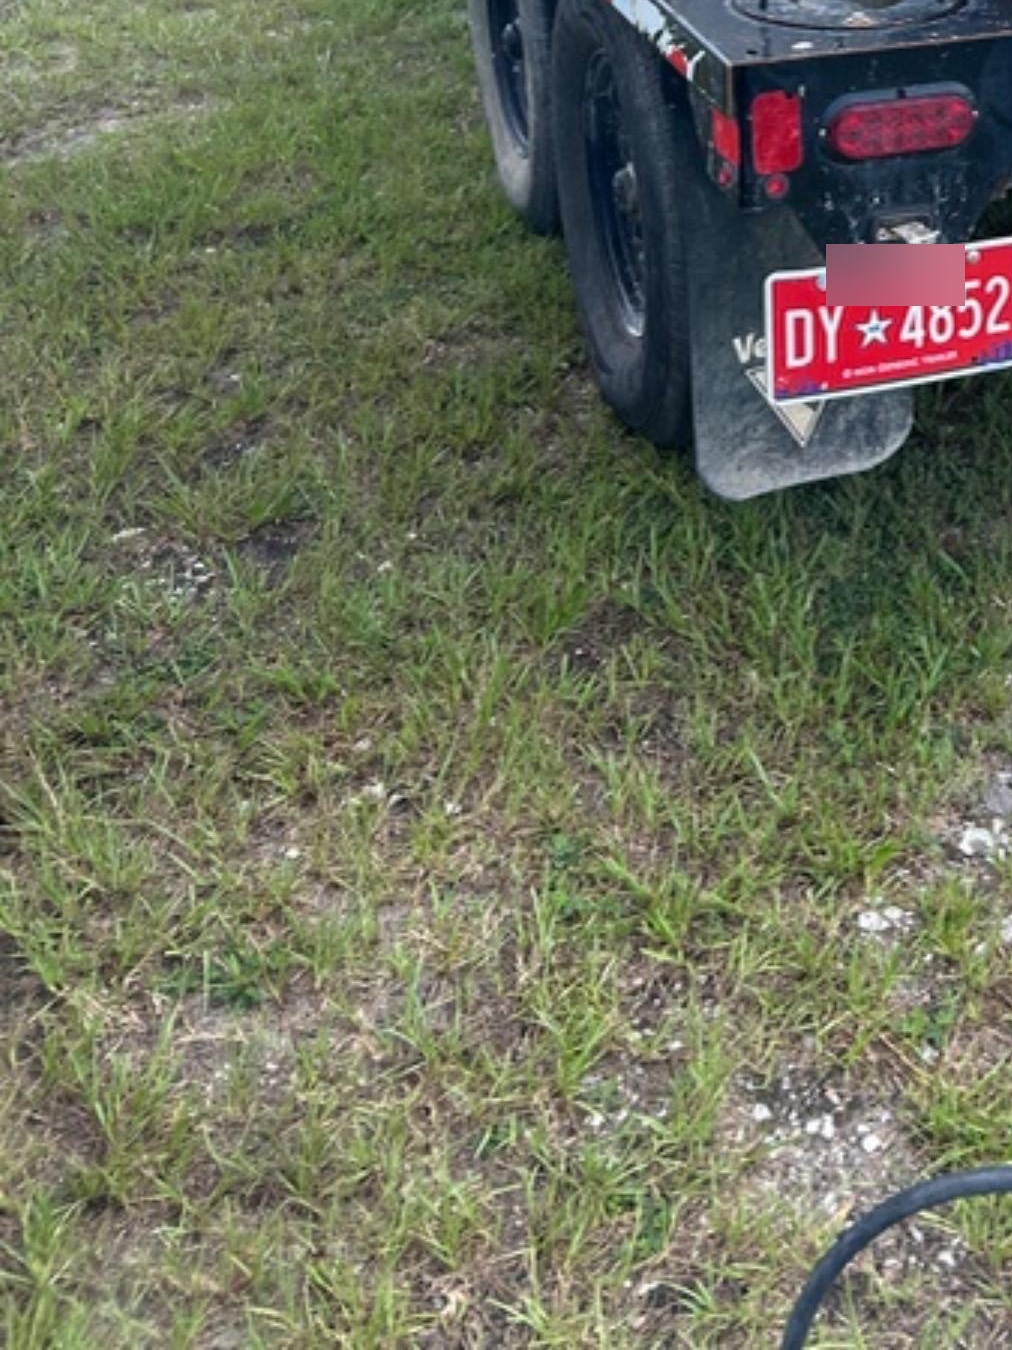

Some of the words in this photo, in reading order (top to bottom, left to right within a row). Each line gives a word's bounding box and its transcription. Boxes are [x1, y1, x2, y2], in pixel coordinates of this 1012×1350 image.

[732, 333, 767, 365] Ve
[784, 304, 845, 370] DY
[899, 275, 1011, 349] 4852
